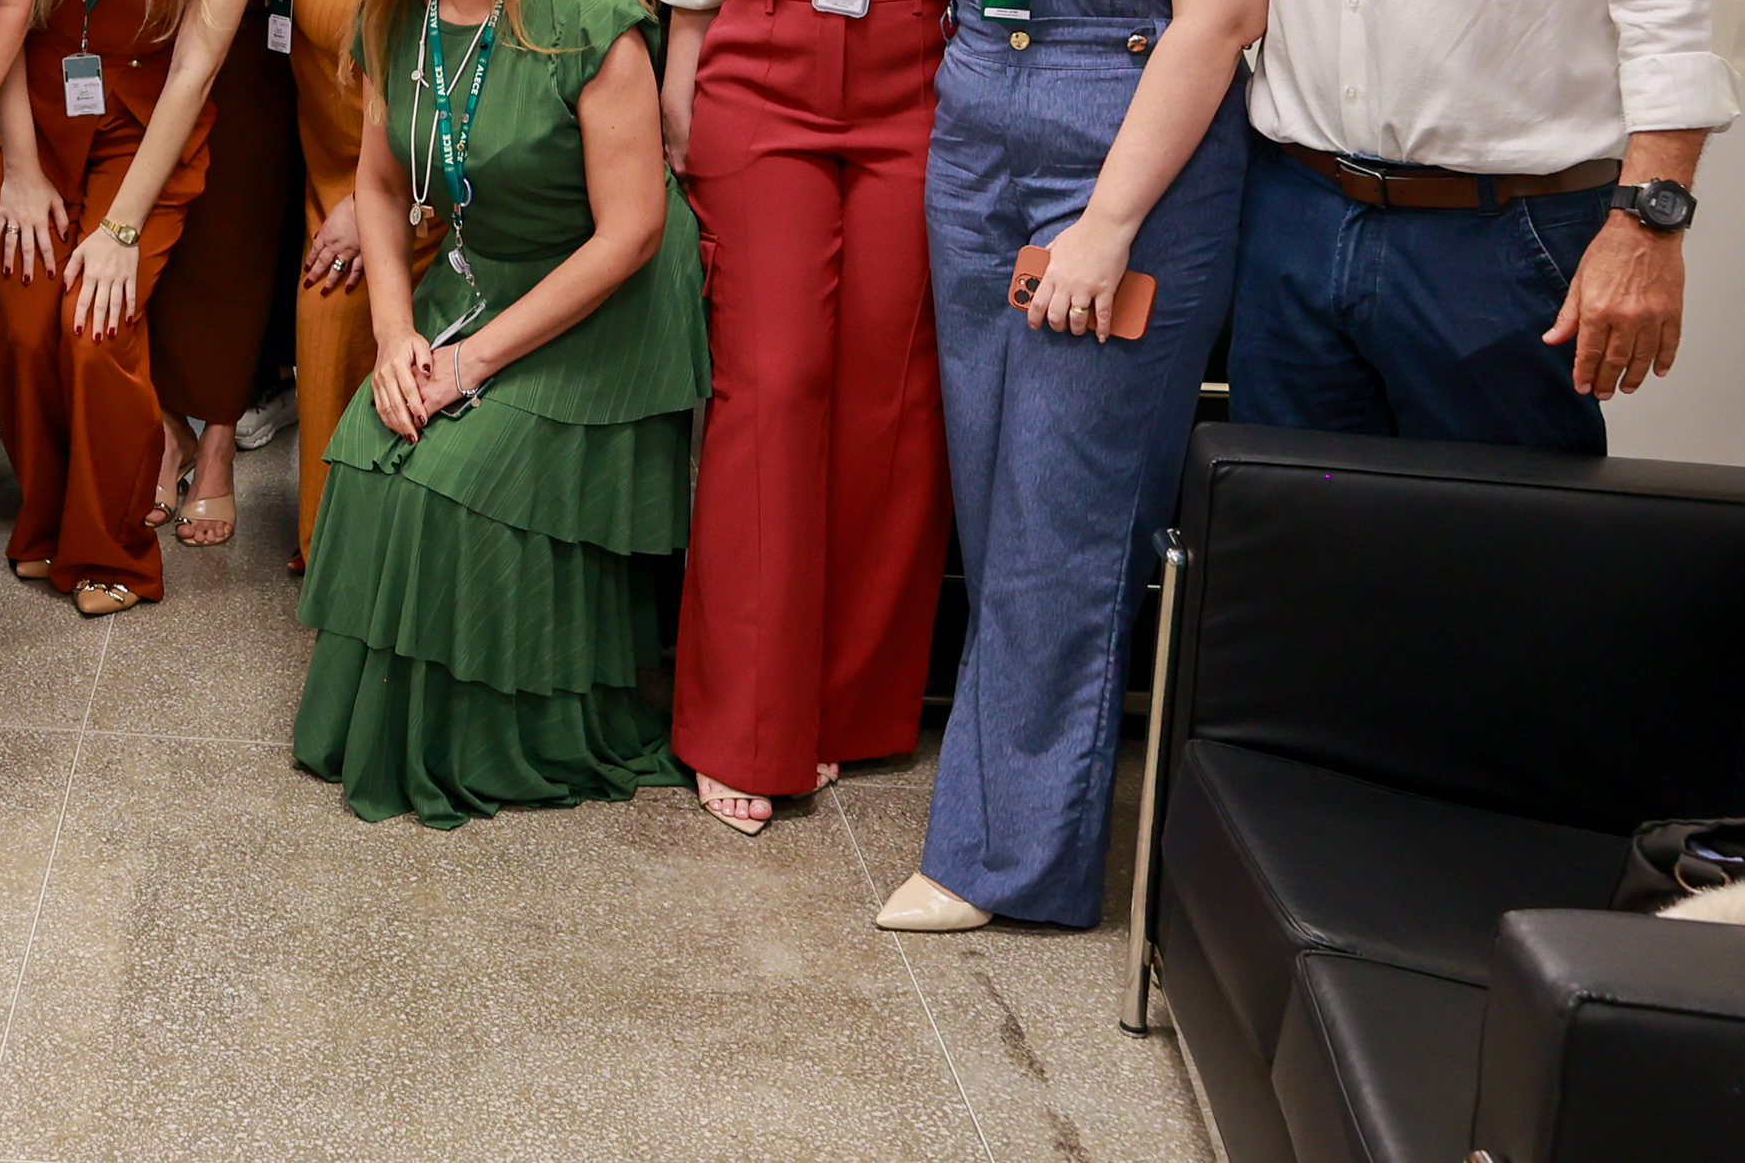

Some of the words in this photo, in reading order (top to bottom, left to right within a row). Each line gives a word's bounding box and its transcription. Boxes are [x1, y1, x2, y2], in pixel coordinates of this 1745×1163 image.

[430, 0, 438, 28] ALECE
[435, 65, 446, 96] ALECE
[470, 64, 485, 96] ALECE
[442, 133, 454, 165] ALECE
